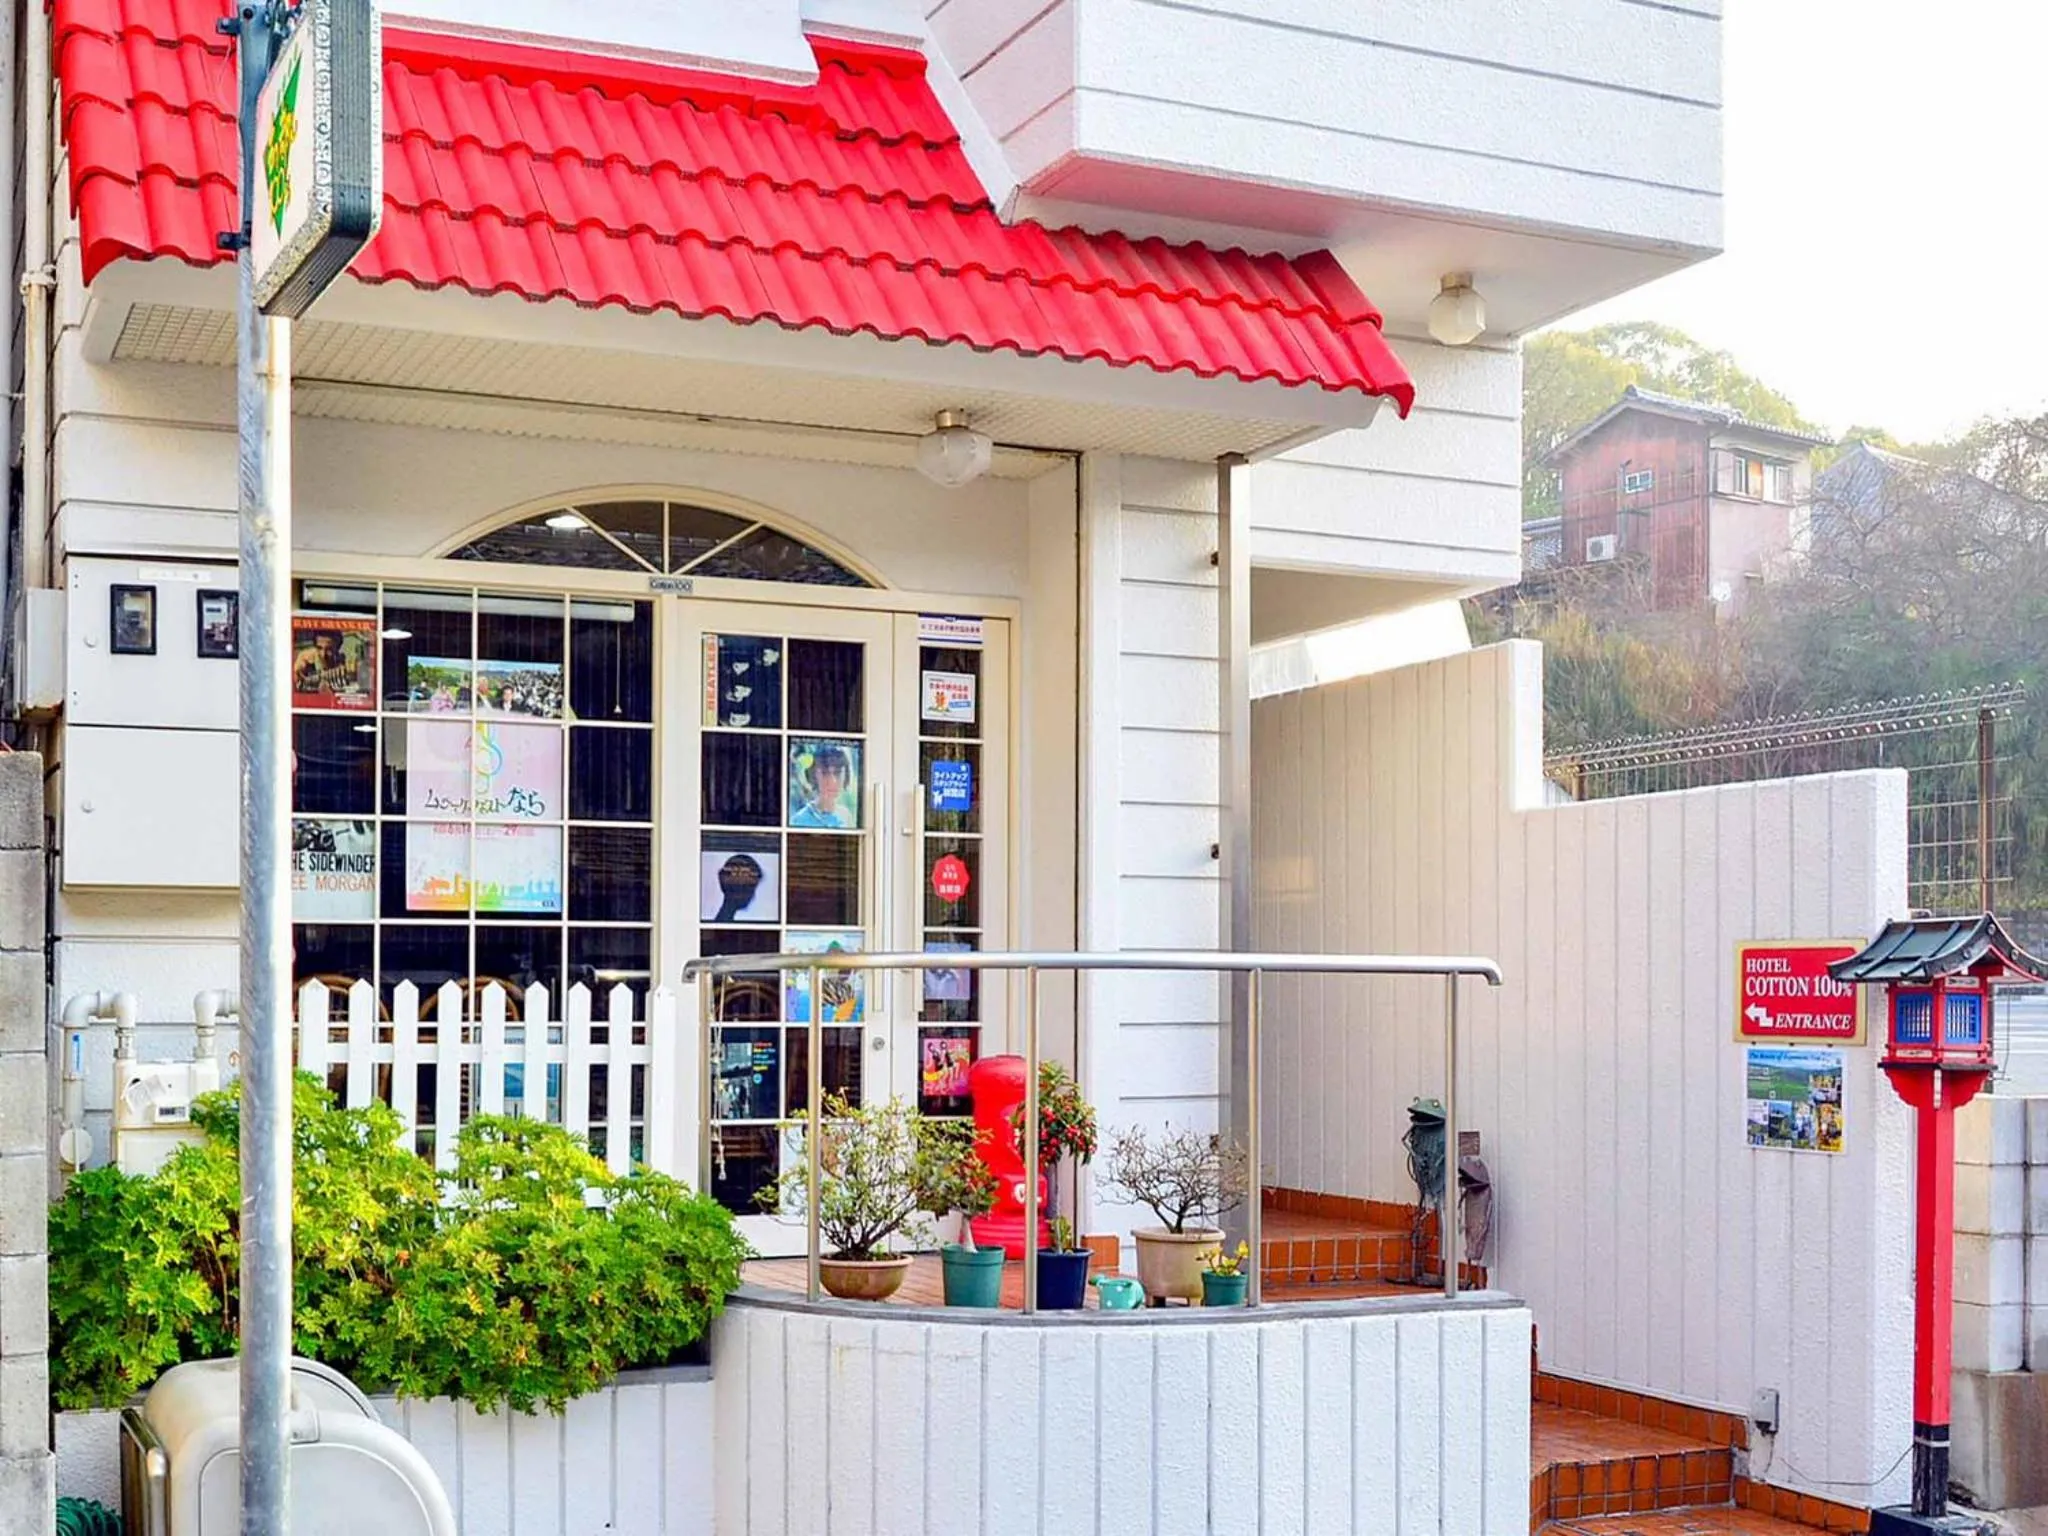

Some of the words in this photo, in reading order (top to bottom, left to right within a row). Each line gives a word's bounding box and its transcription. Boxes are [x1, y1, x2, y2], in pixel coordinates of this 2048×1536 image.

[292, 852, 305, 872] HE
[291, 874, 308, 891] EE
[316, 874, 375, 892] MORGAN
[1745, 958, 1791, 973] HOTEL
[1745, 976, 1810, 997] COTTON
[1774, 1013, 1852, 1030] ENTRANCE
